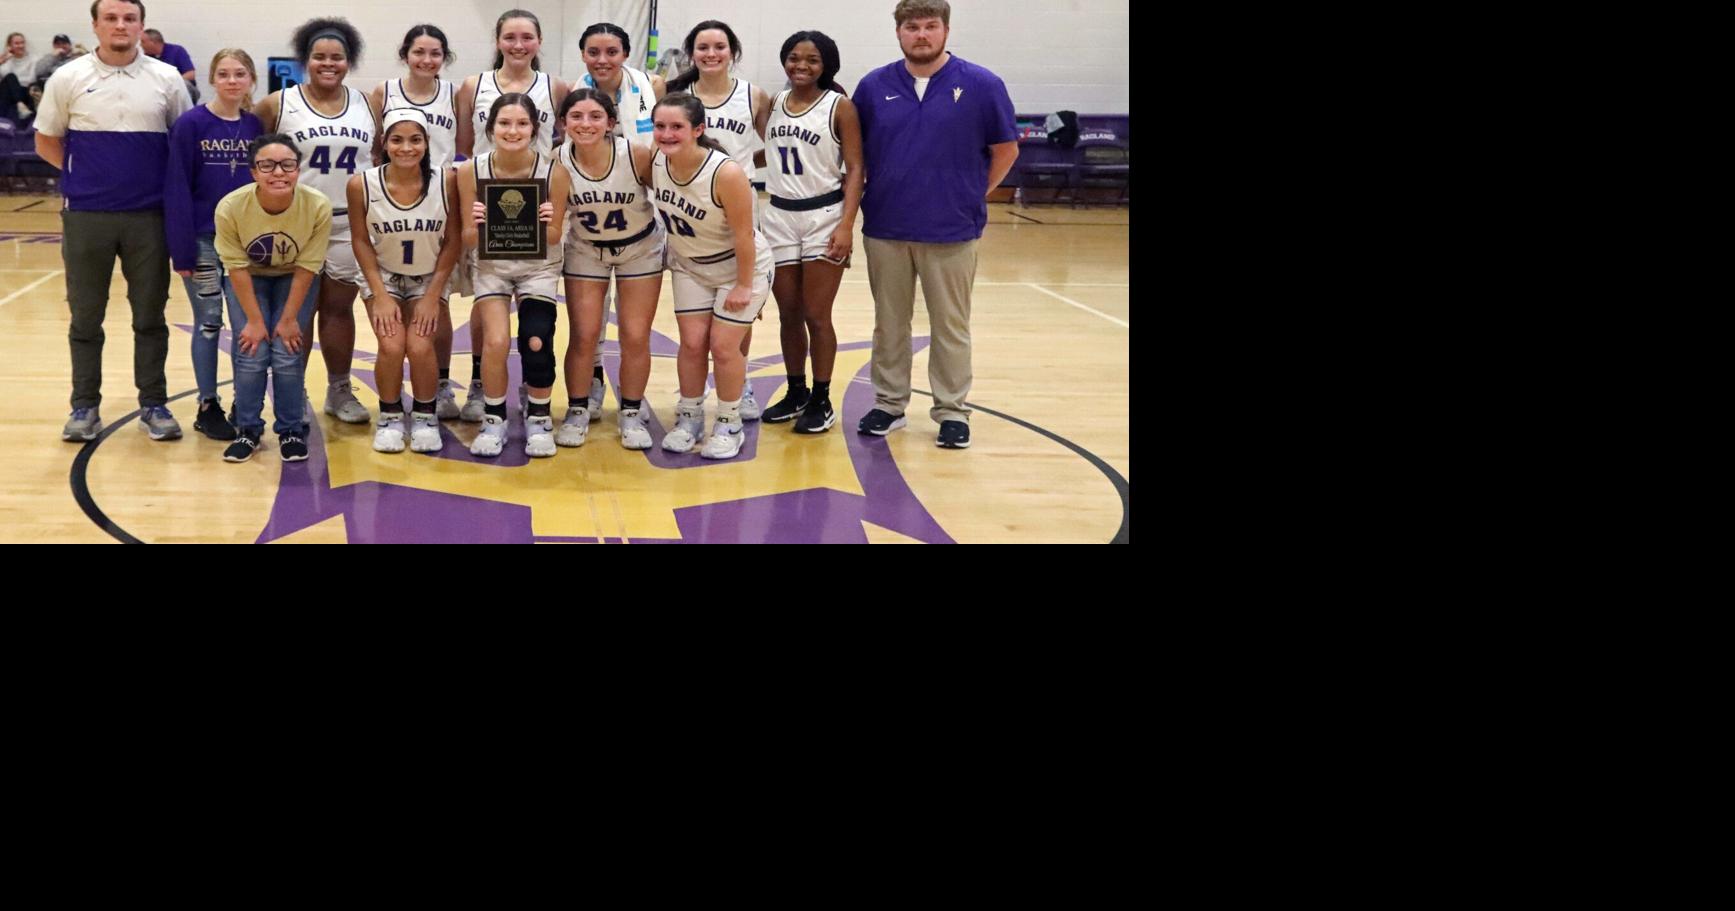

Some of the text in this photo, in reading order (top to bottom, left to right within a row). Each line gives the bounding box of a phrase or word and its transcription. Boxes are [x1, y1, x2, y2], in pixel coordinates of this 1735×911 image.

[294, 126, 369, 143] RAGLAND
[704, 117, 746, 135] LAND
[768, 125, 821, 146] AGLAND
[200, 138, 254, 151] RAGLA
[309, 145, 358, 175] 44
[778, 146, 803, 175] 11
[655, 187, 707, 220] AGLAND
[371, 218, 443, 234] RAGLAND
[576, 209, 628, 234] 24
[401, 240, 414, 265] 1
